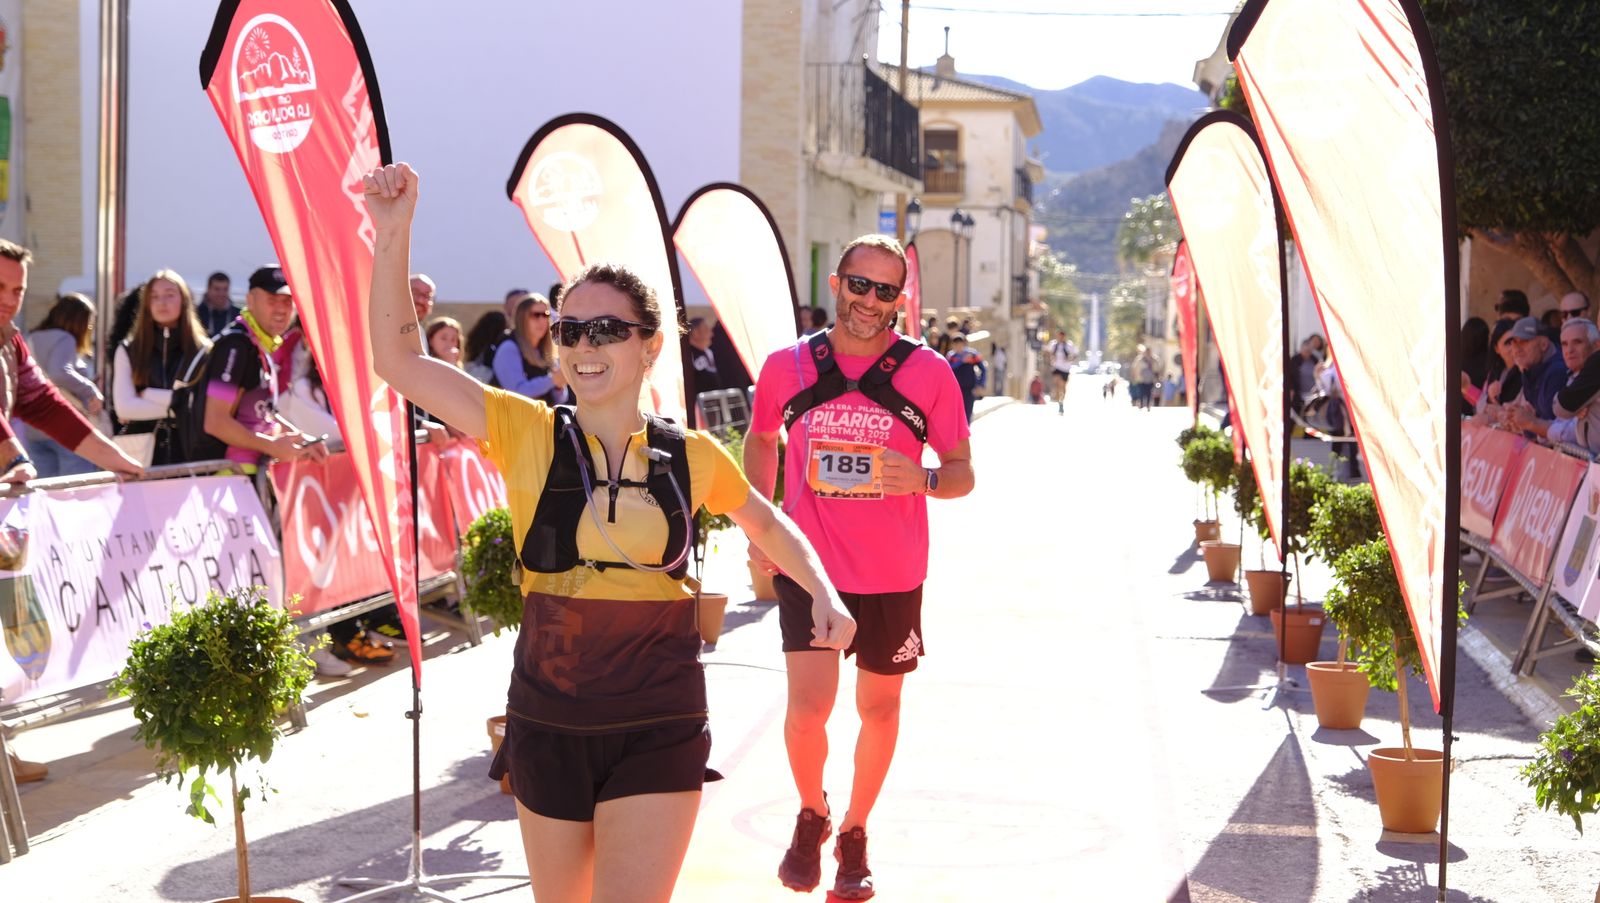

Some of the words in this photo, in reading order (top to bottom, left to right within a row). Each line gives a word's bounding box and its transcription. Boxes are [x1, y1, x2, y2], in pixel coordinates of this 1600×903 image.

[811, 410, 893, 431] PILARICO
[808, 425, 865, 437] CHRISTMAS
[868, 429, 890, 441] 2023
[821, 454, 871, 474] 185
[50, 517, 220, 568] AYUNTAMENTO
[228, 516, 255, 540] DE
[59, 548, 267, 633] CANTORIA
